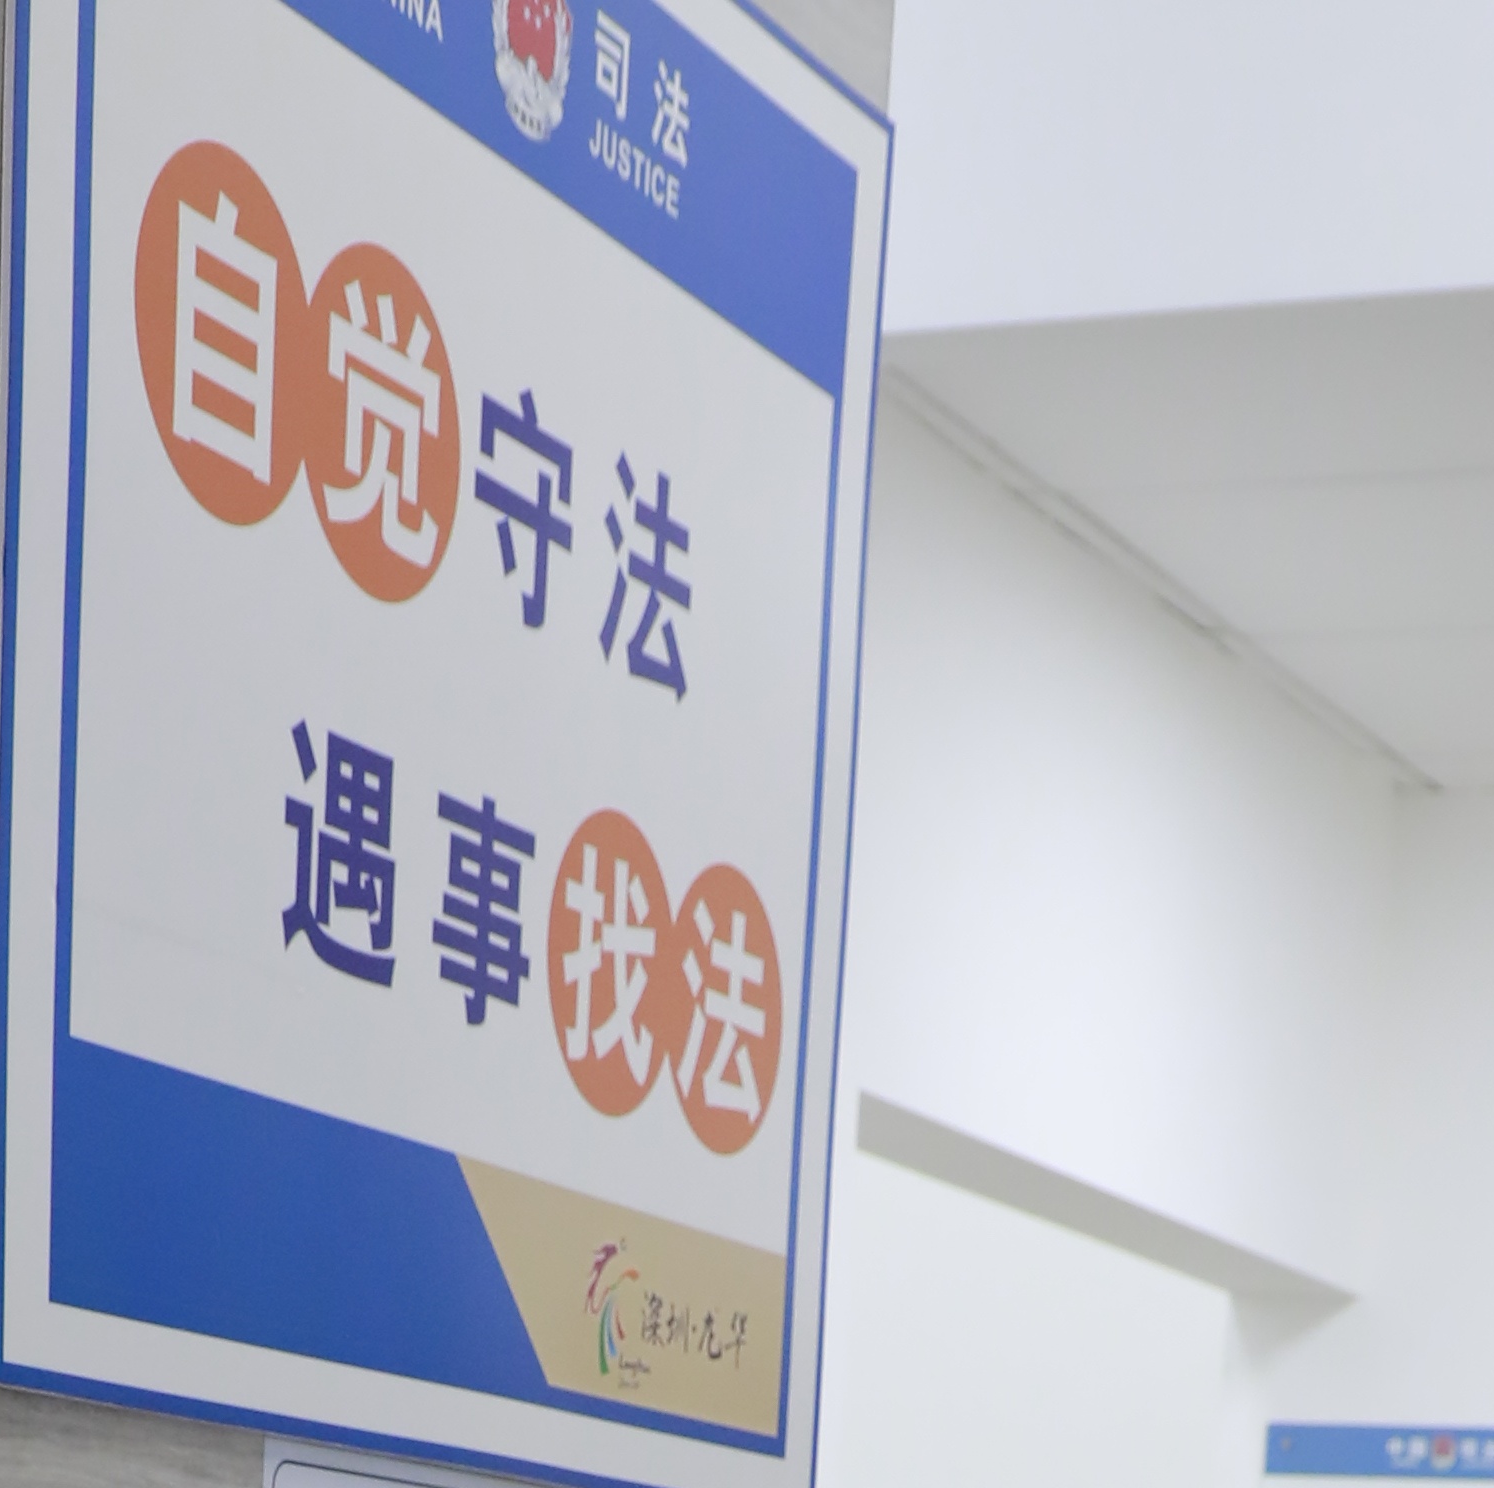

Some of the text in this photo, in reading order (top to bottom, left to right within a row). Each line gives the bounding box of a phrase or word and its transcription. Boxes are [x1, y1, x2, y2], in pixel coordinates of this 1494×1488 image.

[589, 118, 680, 219] JUSTICE
[595, 9, 689, 168] 司法
[173, 190, 691, 702] 自觉守法
[283, 722, 765, 1124] 遇事找法
